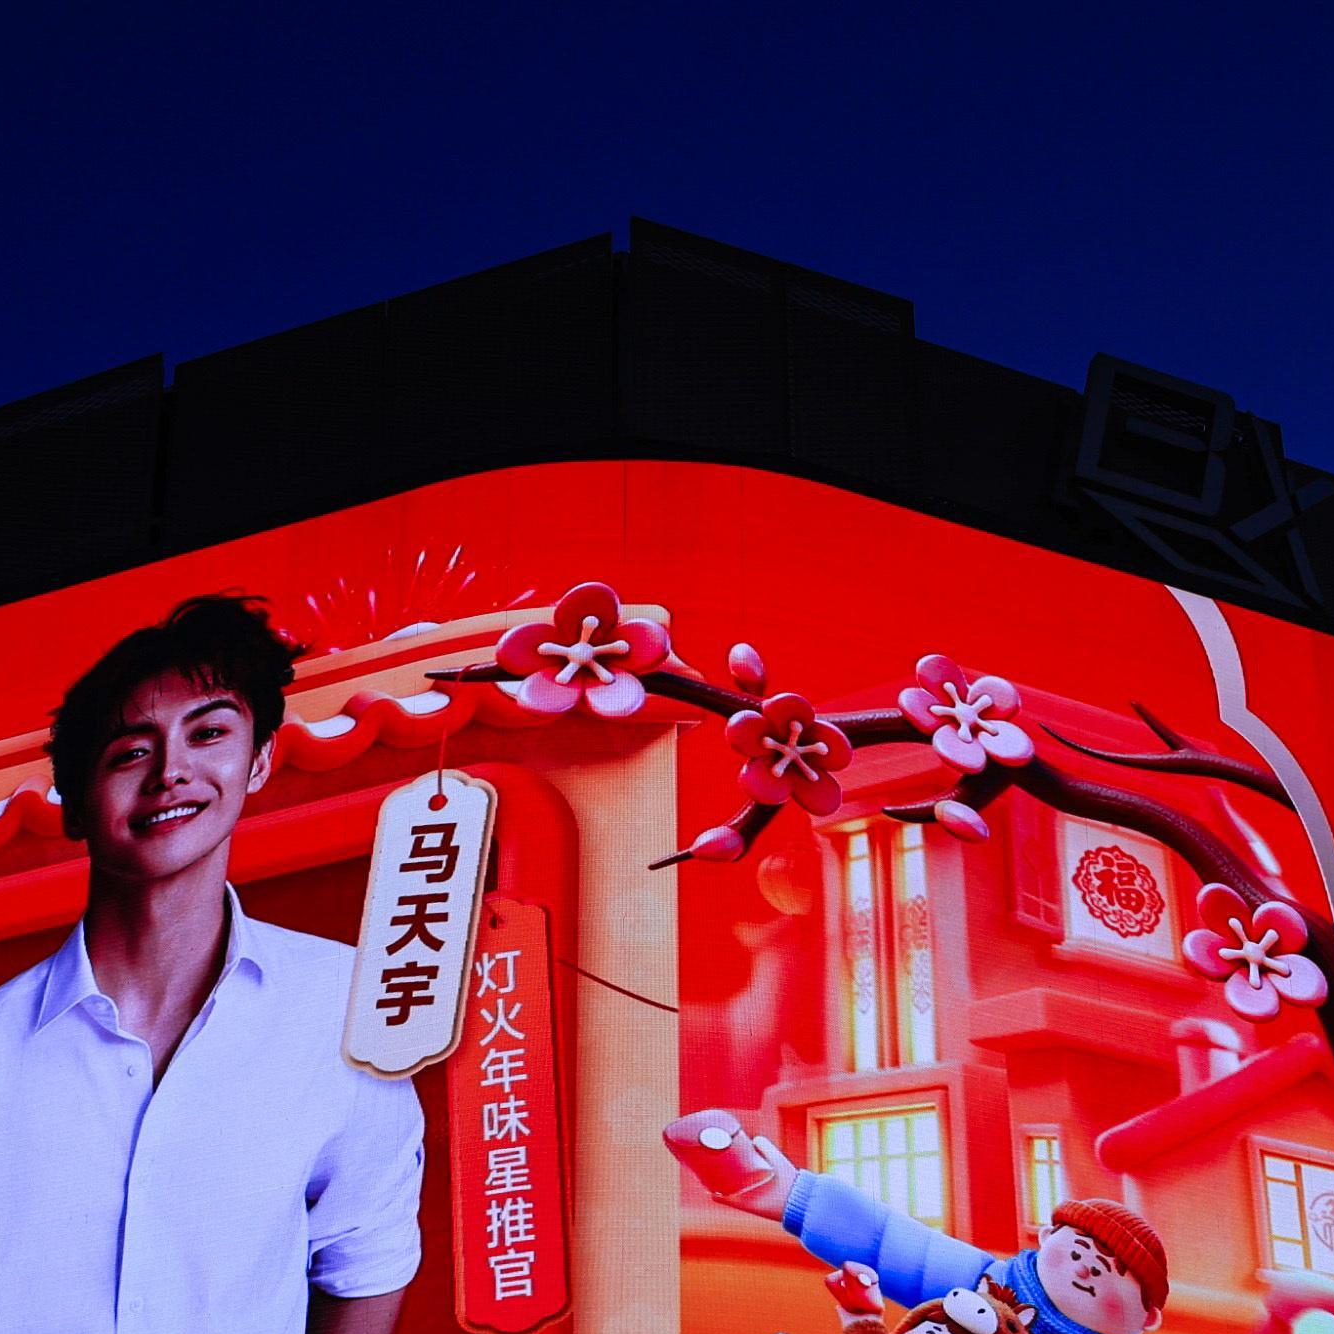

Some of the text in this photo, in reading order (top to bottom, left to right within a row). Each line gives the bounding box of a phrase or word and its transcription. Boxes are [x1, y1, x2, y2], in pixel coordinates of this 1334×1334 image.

[375, 821, 461, 1027] 马天宇
[475, 949, 536, 1301] 灯火年味星推官
